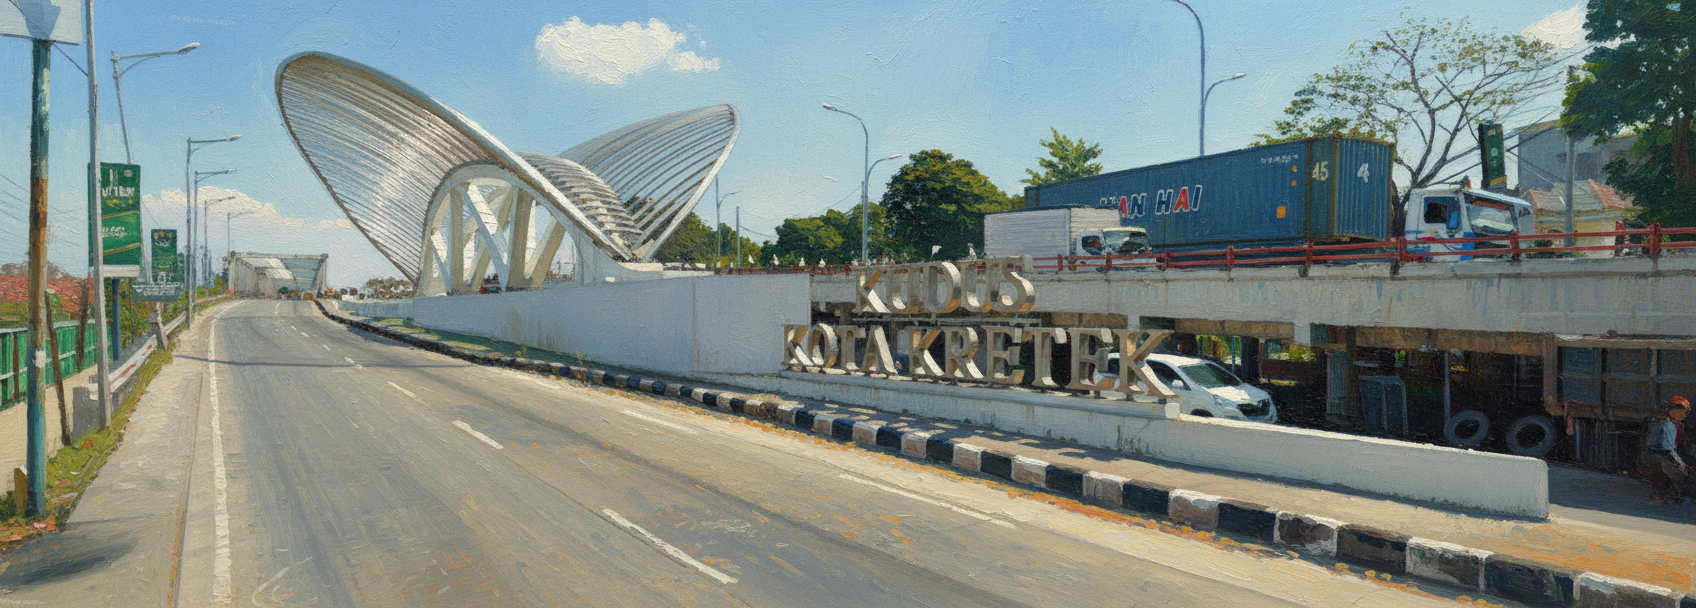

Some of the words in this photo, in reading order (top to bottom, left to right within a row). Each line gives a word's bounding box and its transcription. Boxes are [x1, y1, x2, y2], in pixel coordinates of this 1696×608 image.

[1312, 161, 1329, 181] 45
[1100, 193, 1147, 219] AN
[1155, 185, 1202, 215] HAI
[852, 254, 1036, 314] KUDUS
[781, 322, 898, 376] KOTA
[903, 325, 1179, 398] KRETEK
